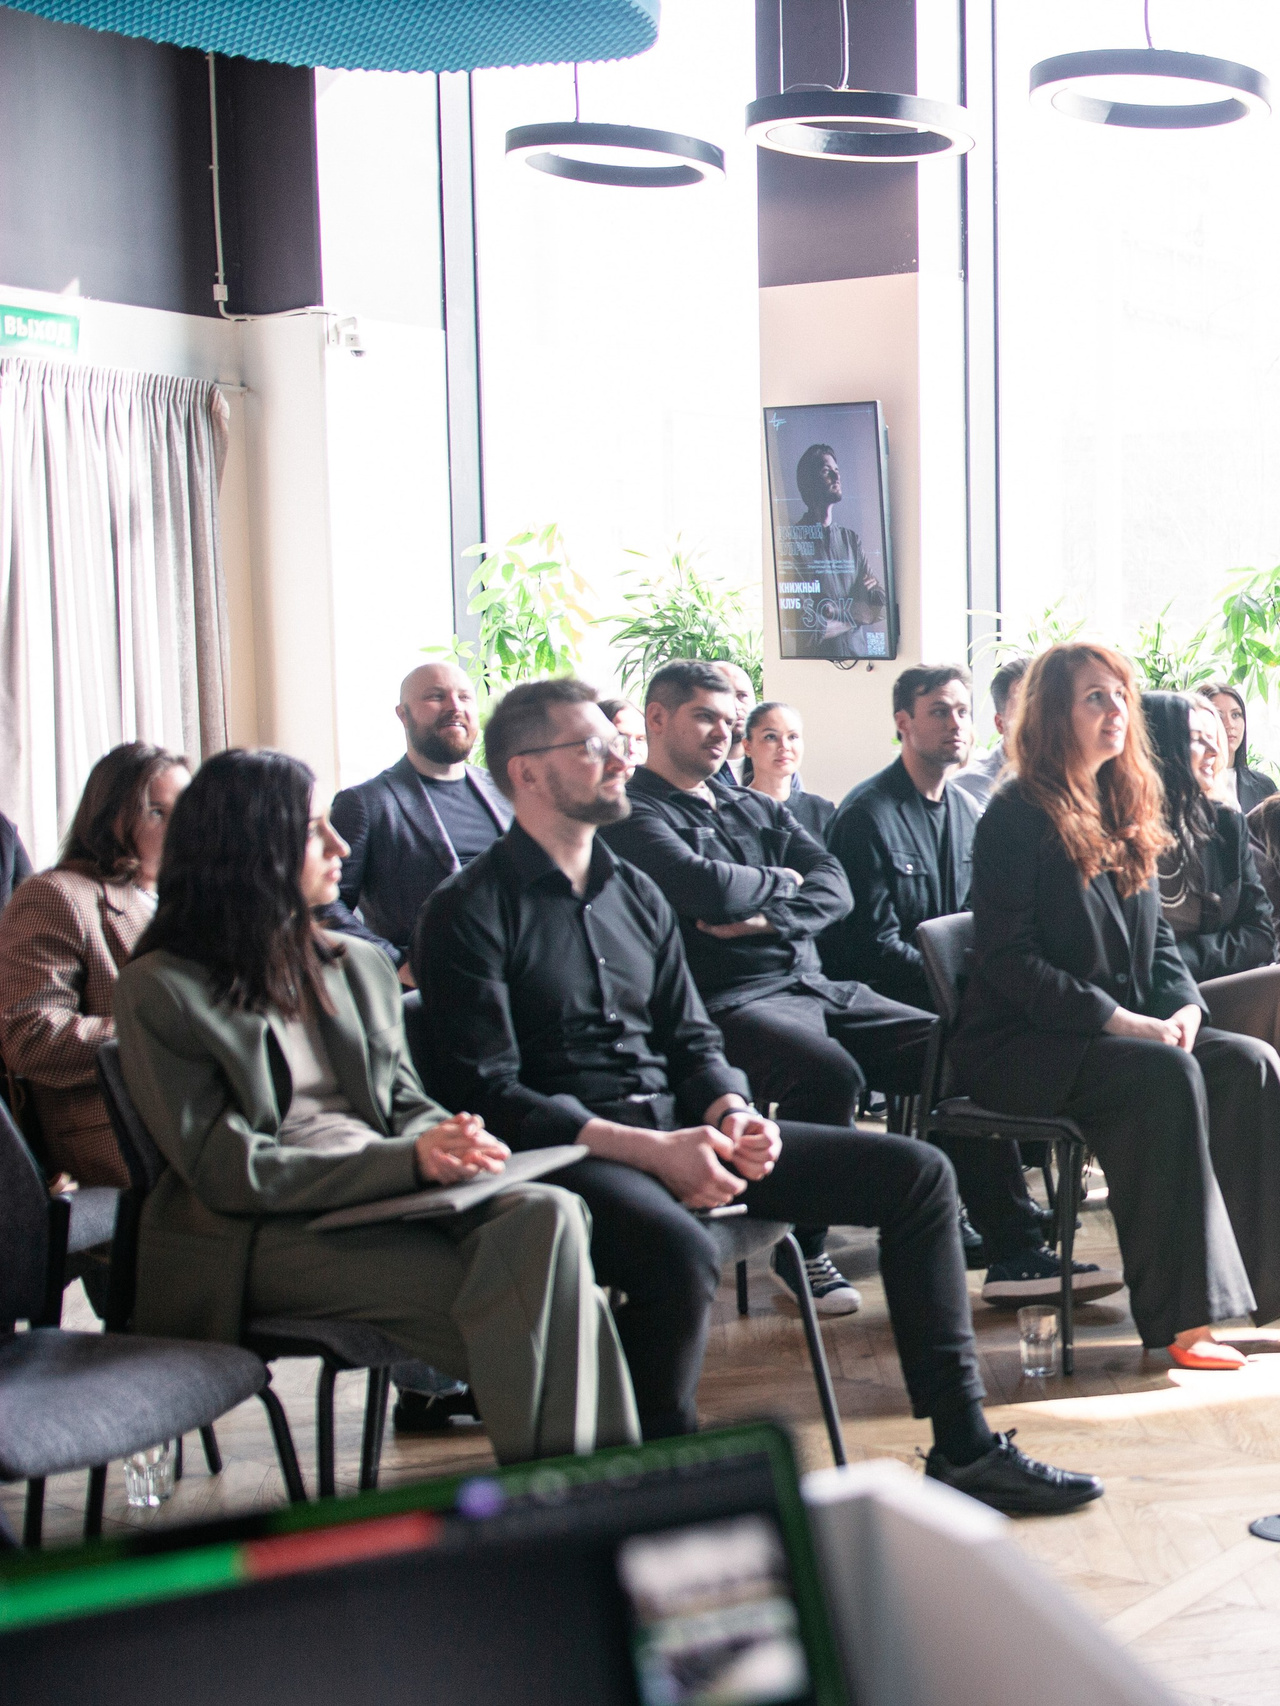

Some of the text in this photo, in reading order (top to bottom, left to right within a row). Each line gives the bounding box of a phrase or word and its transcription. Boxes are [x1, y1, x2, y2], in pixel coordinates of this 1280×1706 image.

[4, 314, 72, 347] ВЫХОД
[779, 580, 821, 594] КНИЖНЫЙ
[779, 597, 857, 628] КЛУБ SOK
